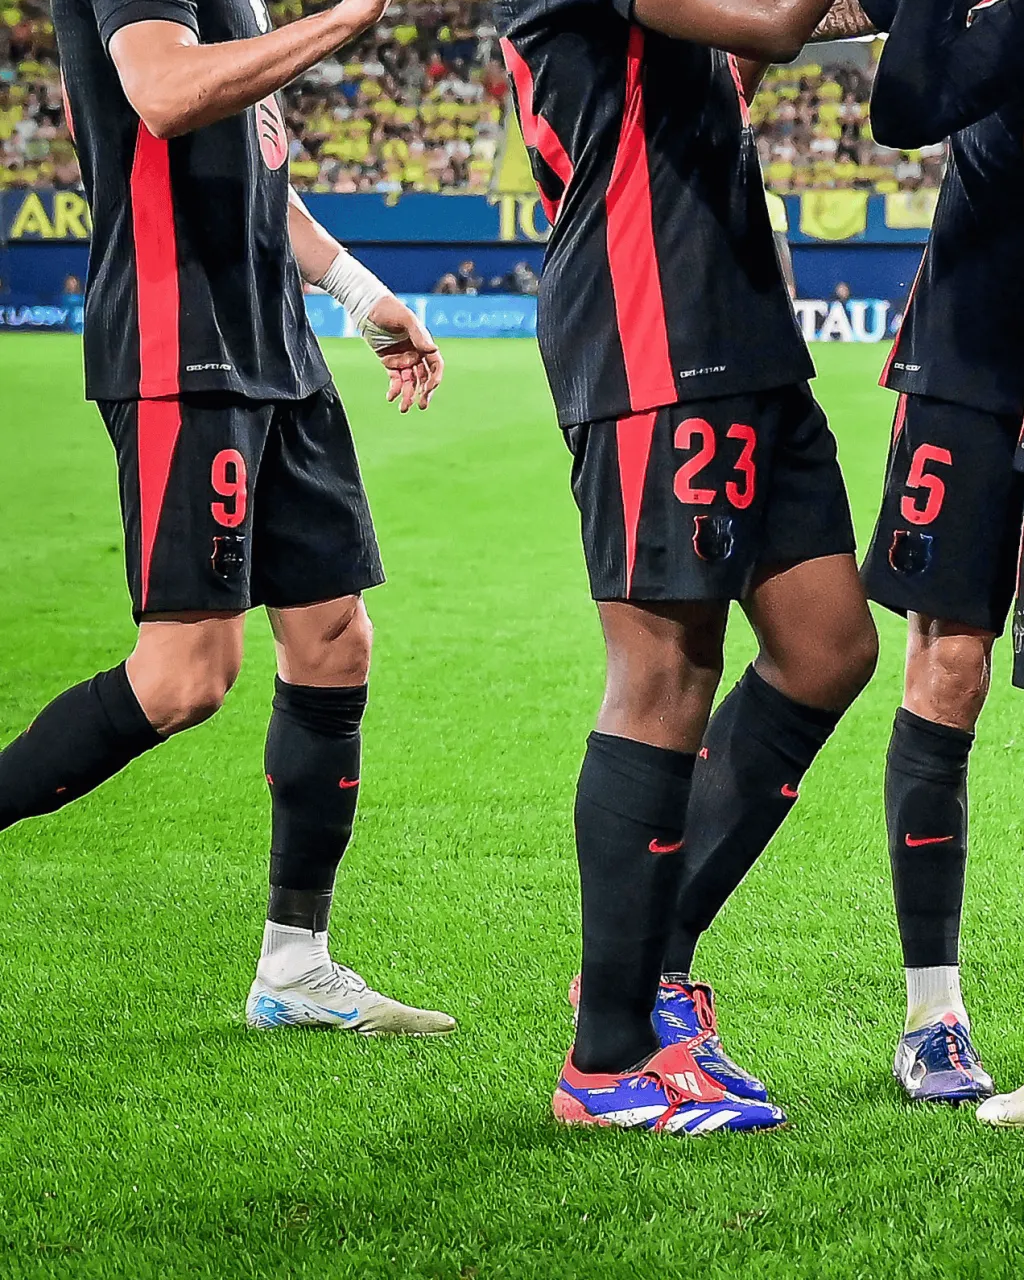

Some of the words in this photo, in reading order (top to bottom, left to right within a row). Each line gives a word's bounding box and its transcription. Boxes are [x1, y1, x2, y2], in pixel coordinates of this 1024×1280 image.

[211, 448, 248, 528] 9
[673, 417, 757, 510] 23
[900, 443, 953, 526] 5
